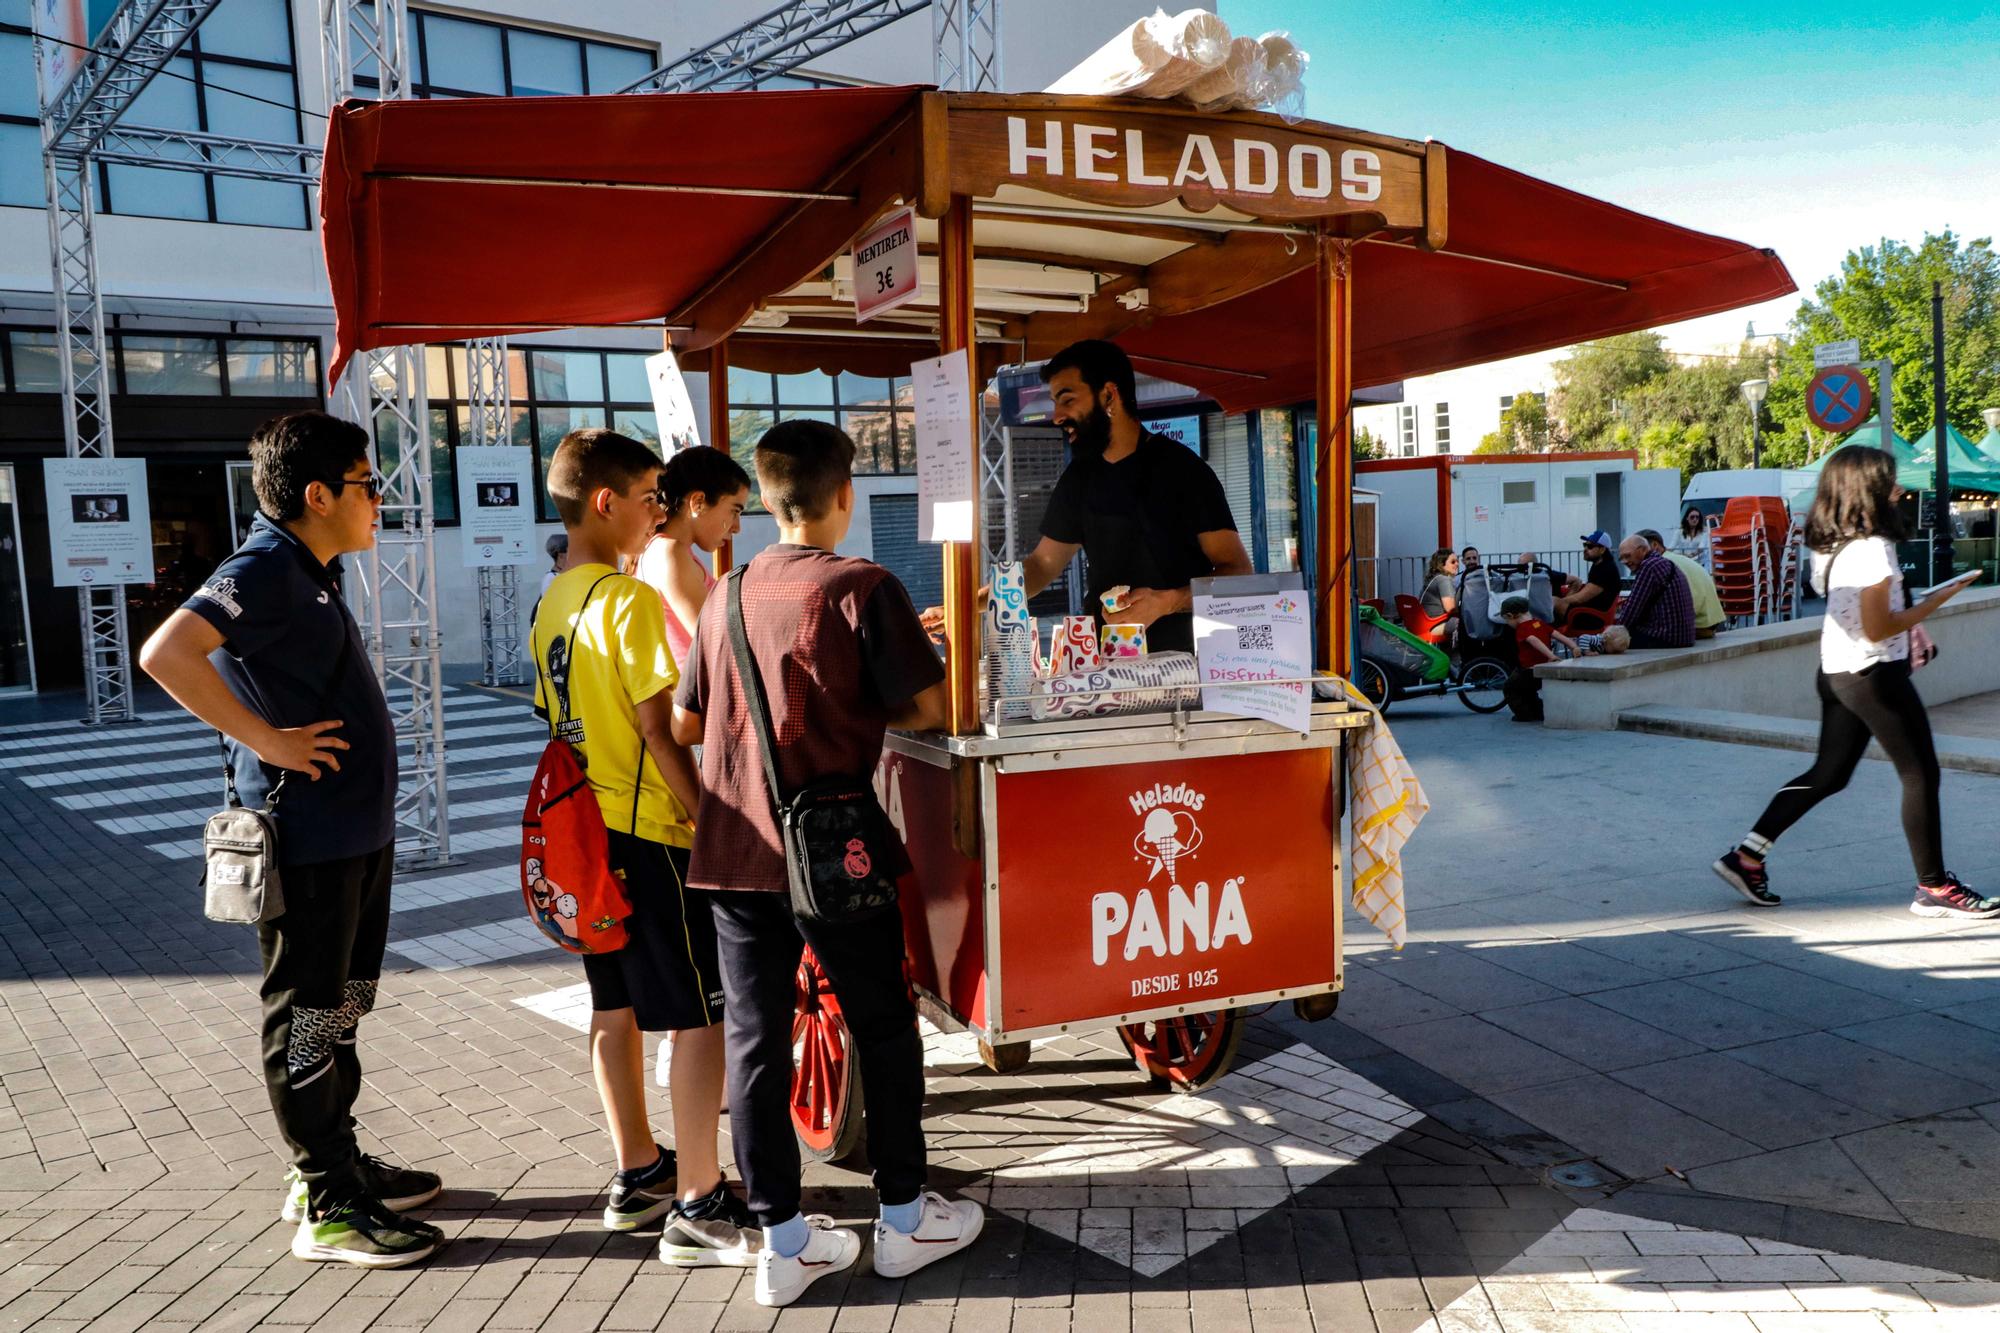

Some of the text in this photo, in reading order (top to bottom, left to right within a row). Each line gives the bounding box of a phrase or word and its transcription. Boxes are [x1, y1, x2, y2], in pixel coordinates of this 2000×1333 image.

[1006, 116, 1383, 202] HELADOS
[856, 227, 910, 268] MENTIRETA
[875, 266, 895, 294] 3€
[1150, 421, 1171, 432] Mega
[1129, 782, 1207, 817] Helados
[1091, 878, 1253, 967] PANA
[1131, 968, 1219, 998] DESDE 1925
